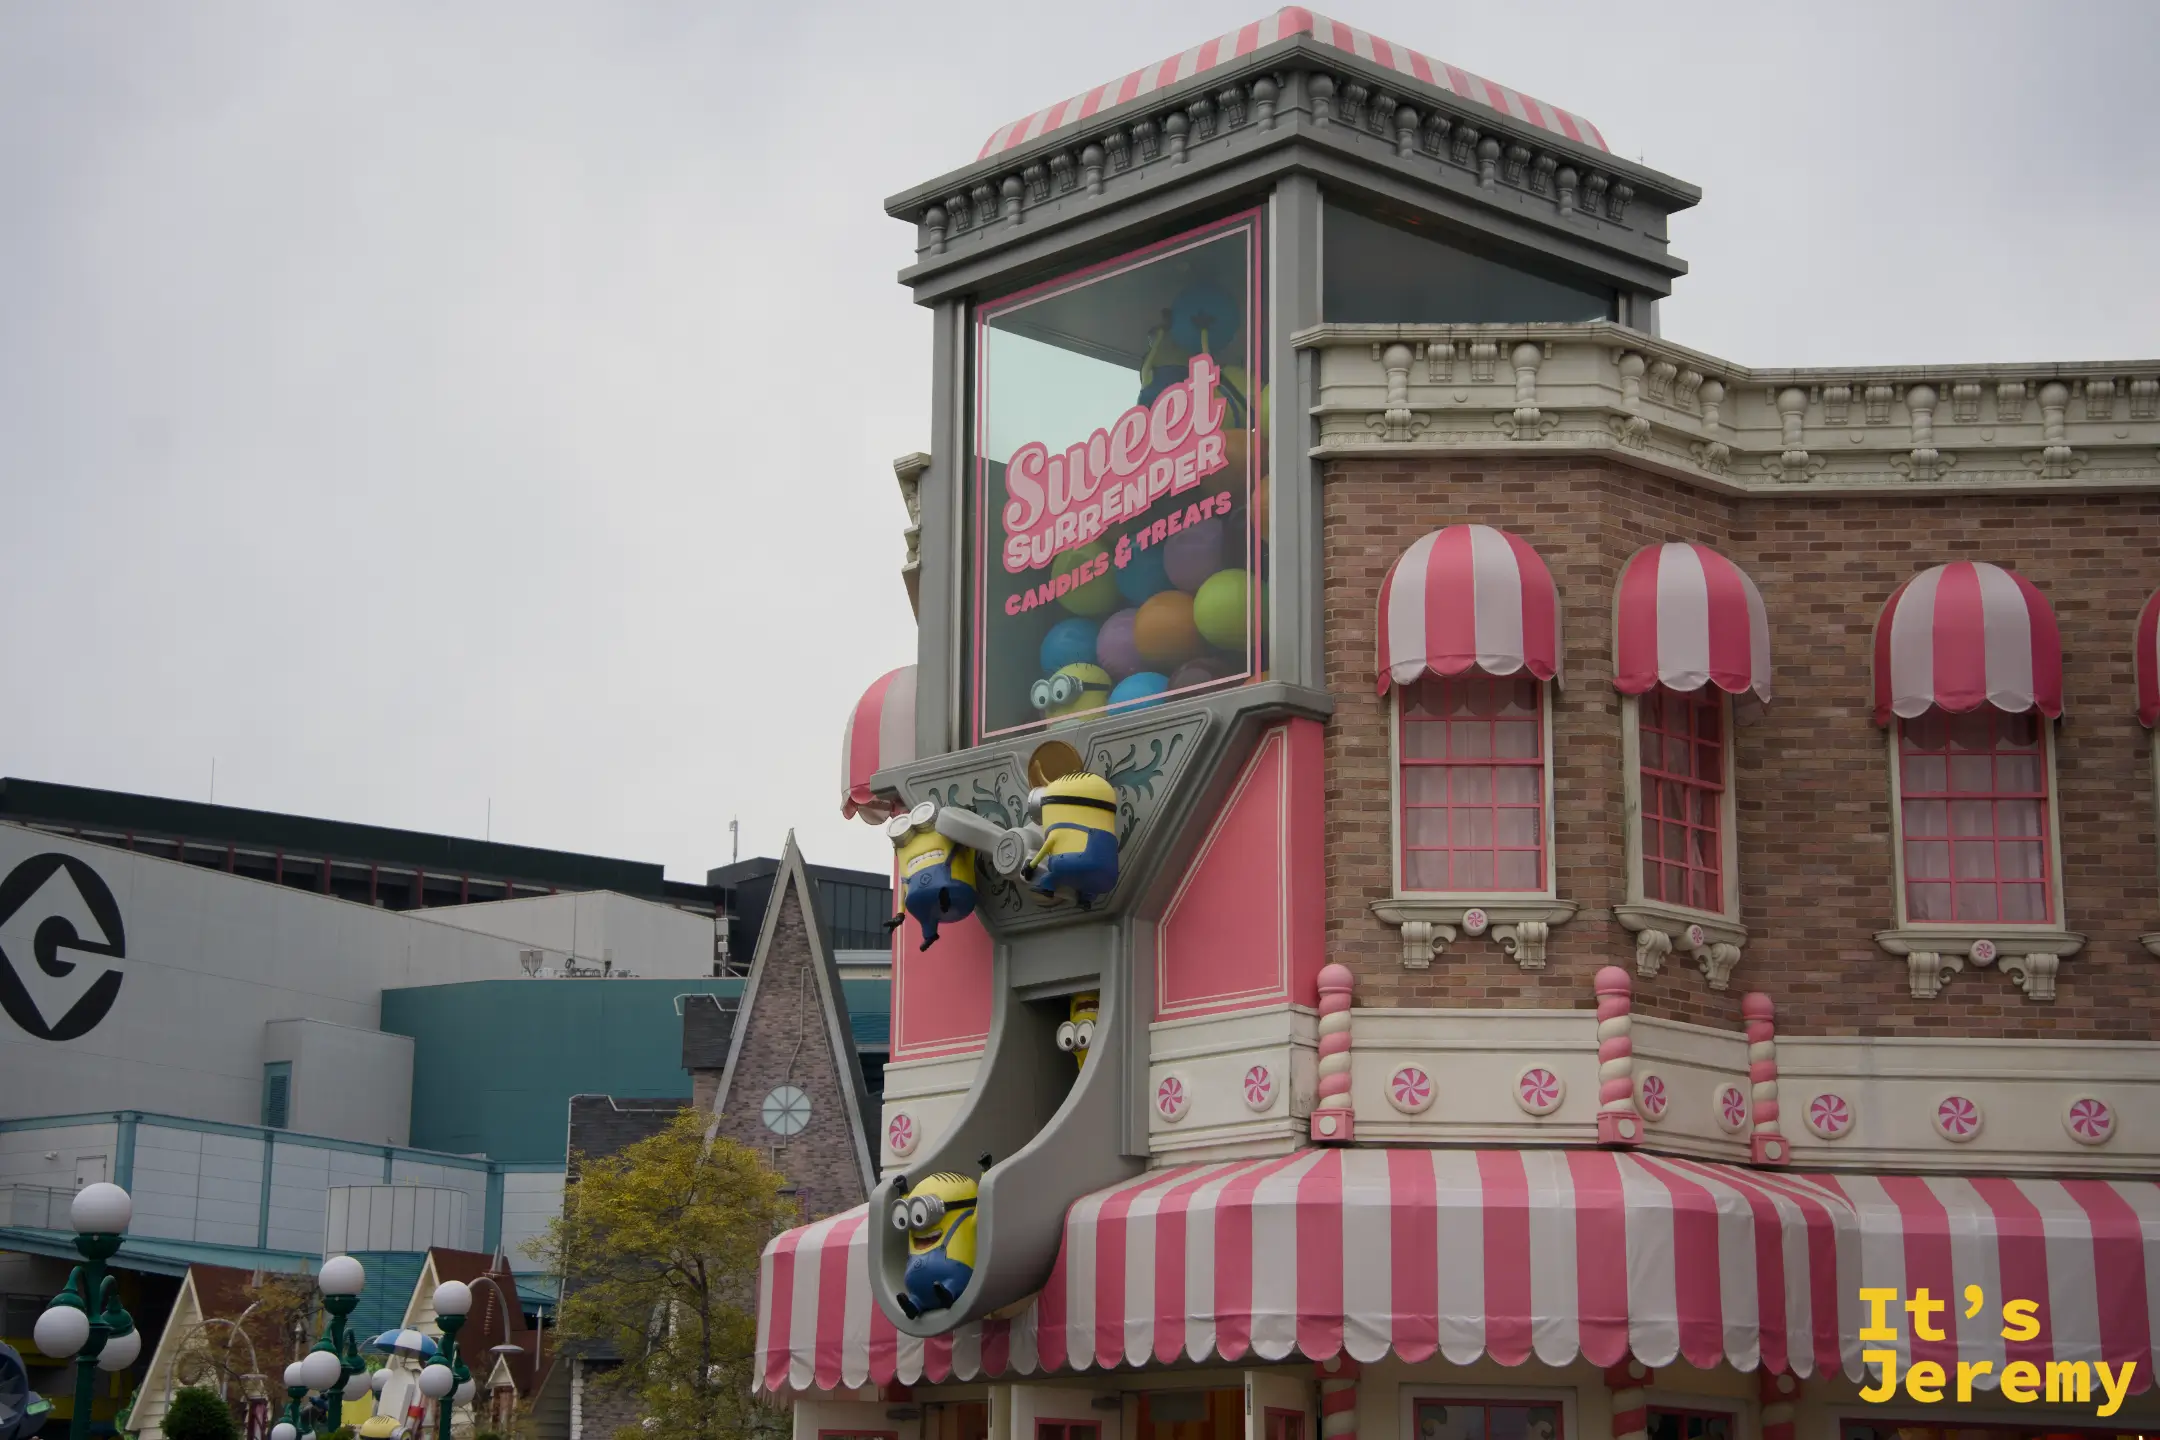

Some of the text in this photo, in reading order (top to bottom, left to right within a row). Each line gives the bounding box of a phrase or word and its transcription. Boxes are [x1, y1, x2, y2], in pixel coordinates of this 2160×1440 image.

[1005, 357, 1223, 532] Sweet
[1006, 434, 1224, 569] SURRENDER
[1004, 491, 1232, 616] CANDIES & TREATS
